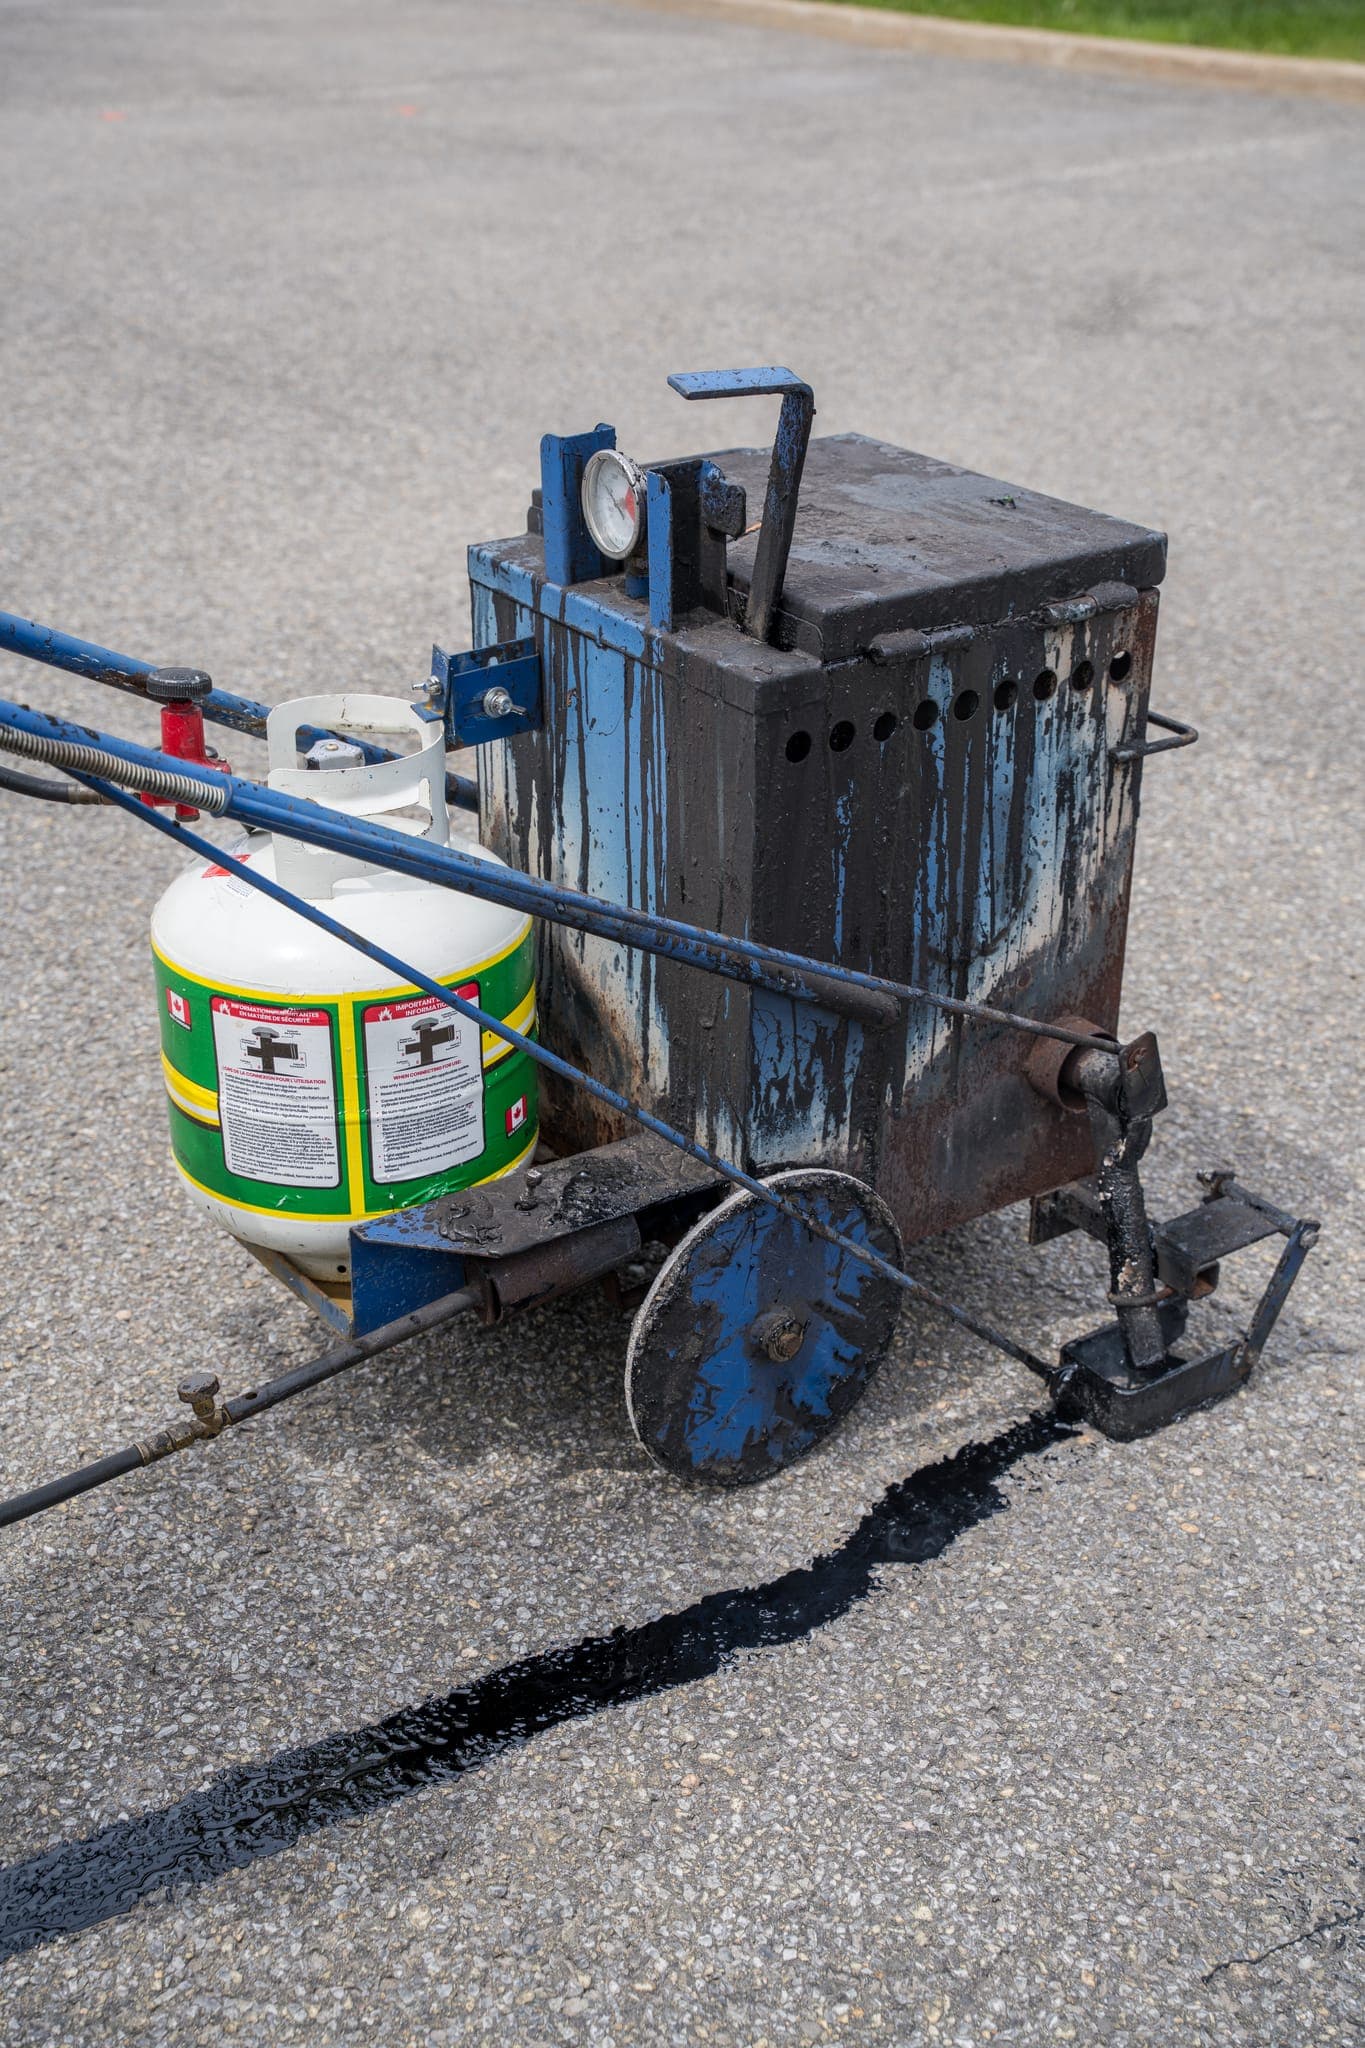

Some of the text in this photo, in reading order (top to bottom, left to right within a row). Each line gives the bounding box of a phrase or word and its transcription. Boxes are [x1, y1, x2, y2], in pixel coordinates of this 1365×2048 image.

[395, 997, 436, 1011] IMPORTANT
[405, 1002, 447, 1016] INFORMATIO
[393, 1073, 410, 1081] WHEN
